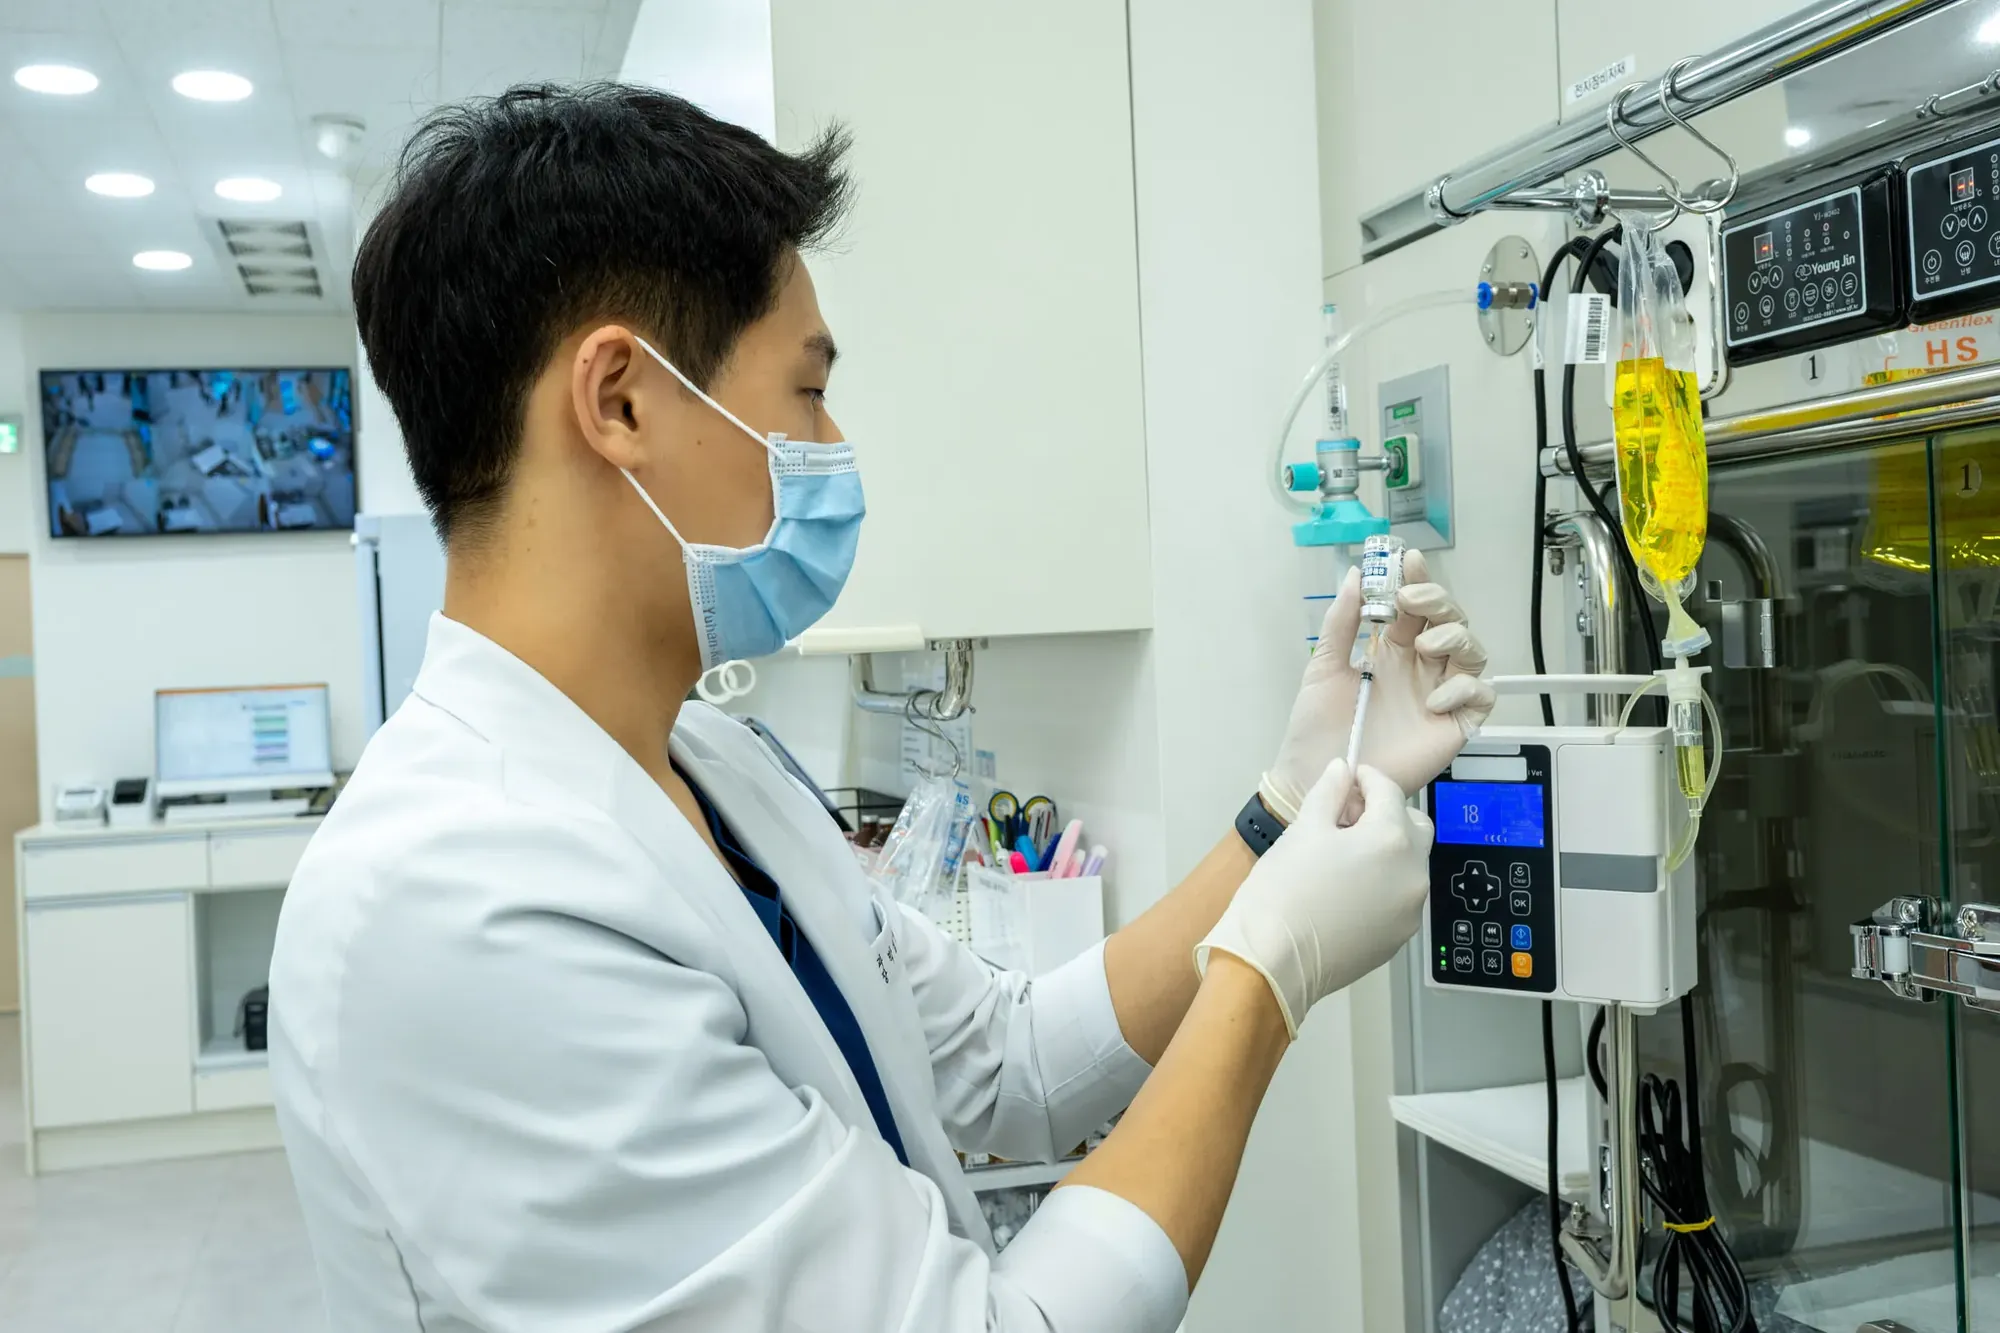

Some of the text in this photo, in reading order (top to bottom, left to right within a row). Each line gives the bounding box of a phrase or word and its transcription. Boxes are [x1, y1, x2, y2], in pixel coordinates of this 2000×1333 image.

[1812, 253, 1856, 276] Young Jin
[1926, 336, 1979, 366] HS
[1809, 354, 1819, 381] 1
[1961, 464, 1972, 491] 1
[1462, 804, 1479, 824] 18
[1513, 899, 1527, 907] OK
